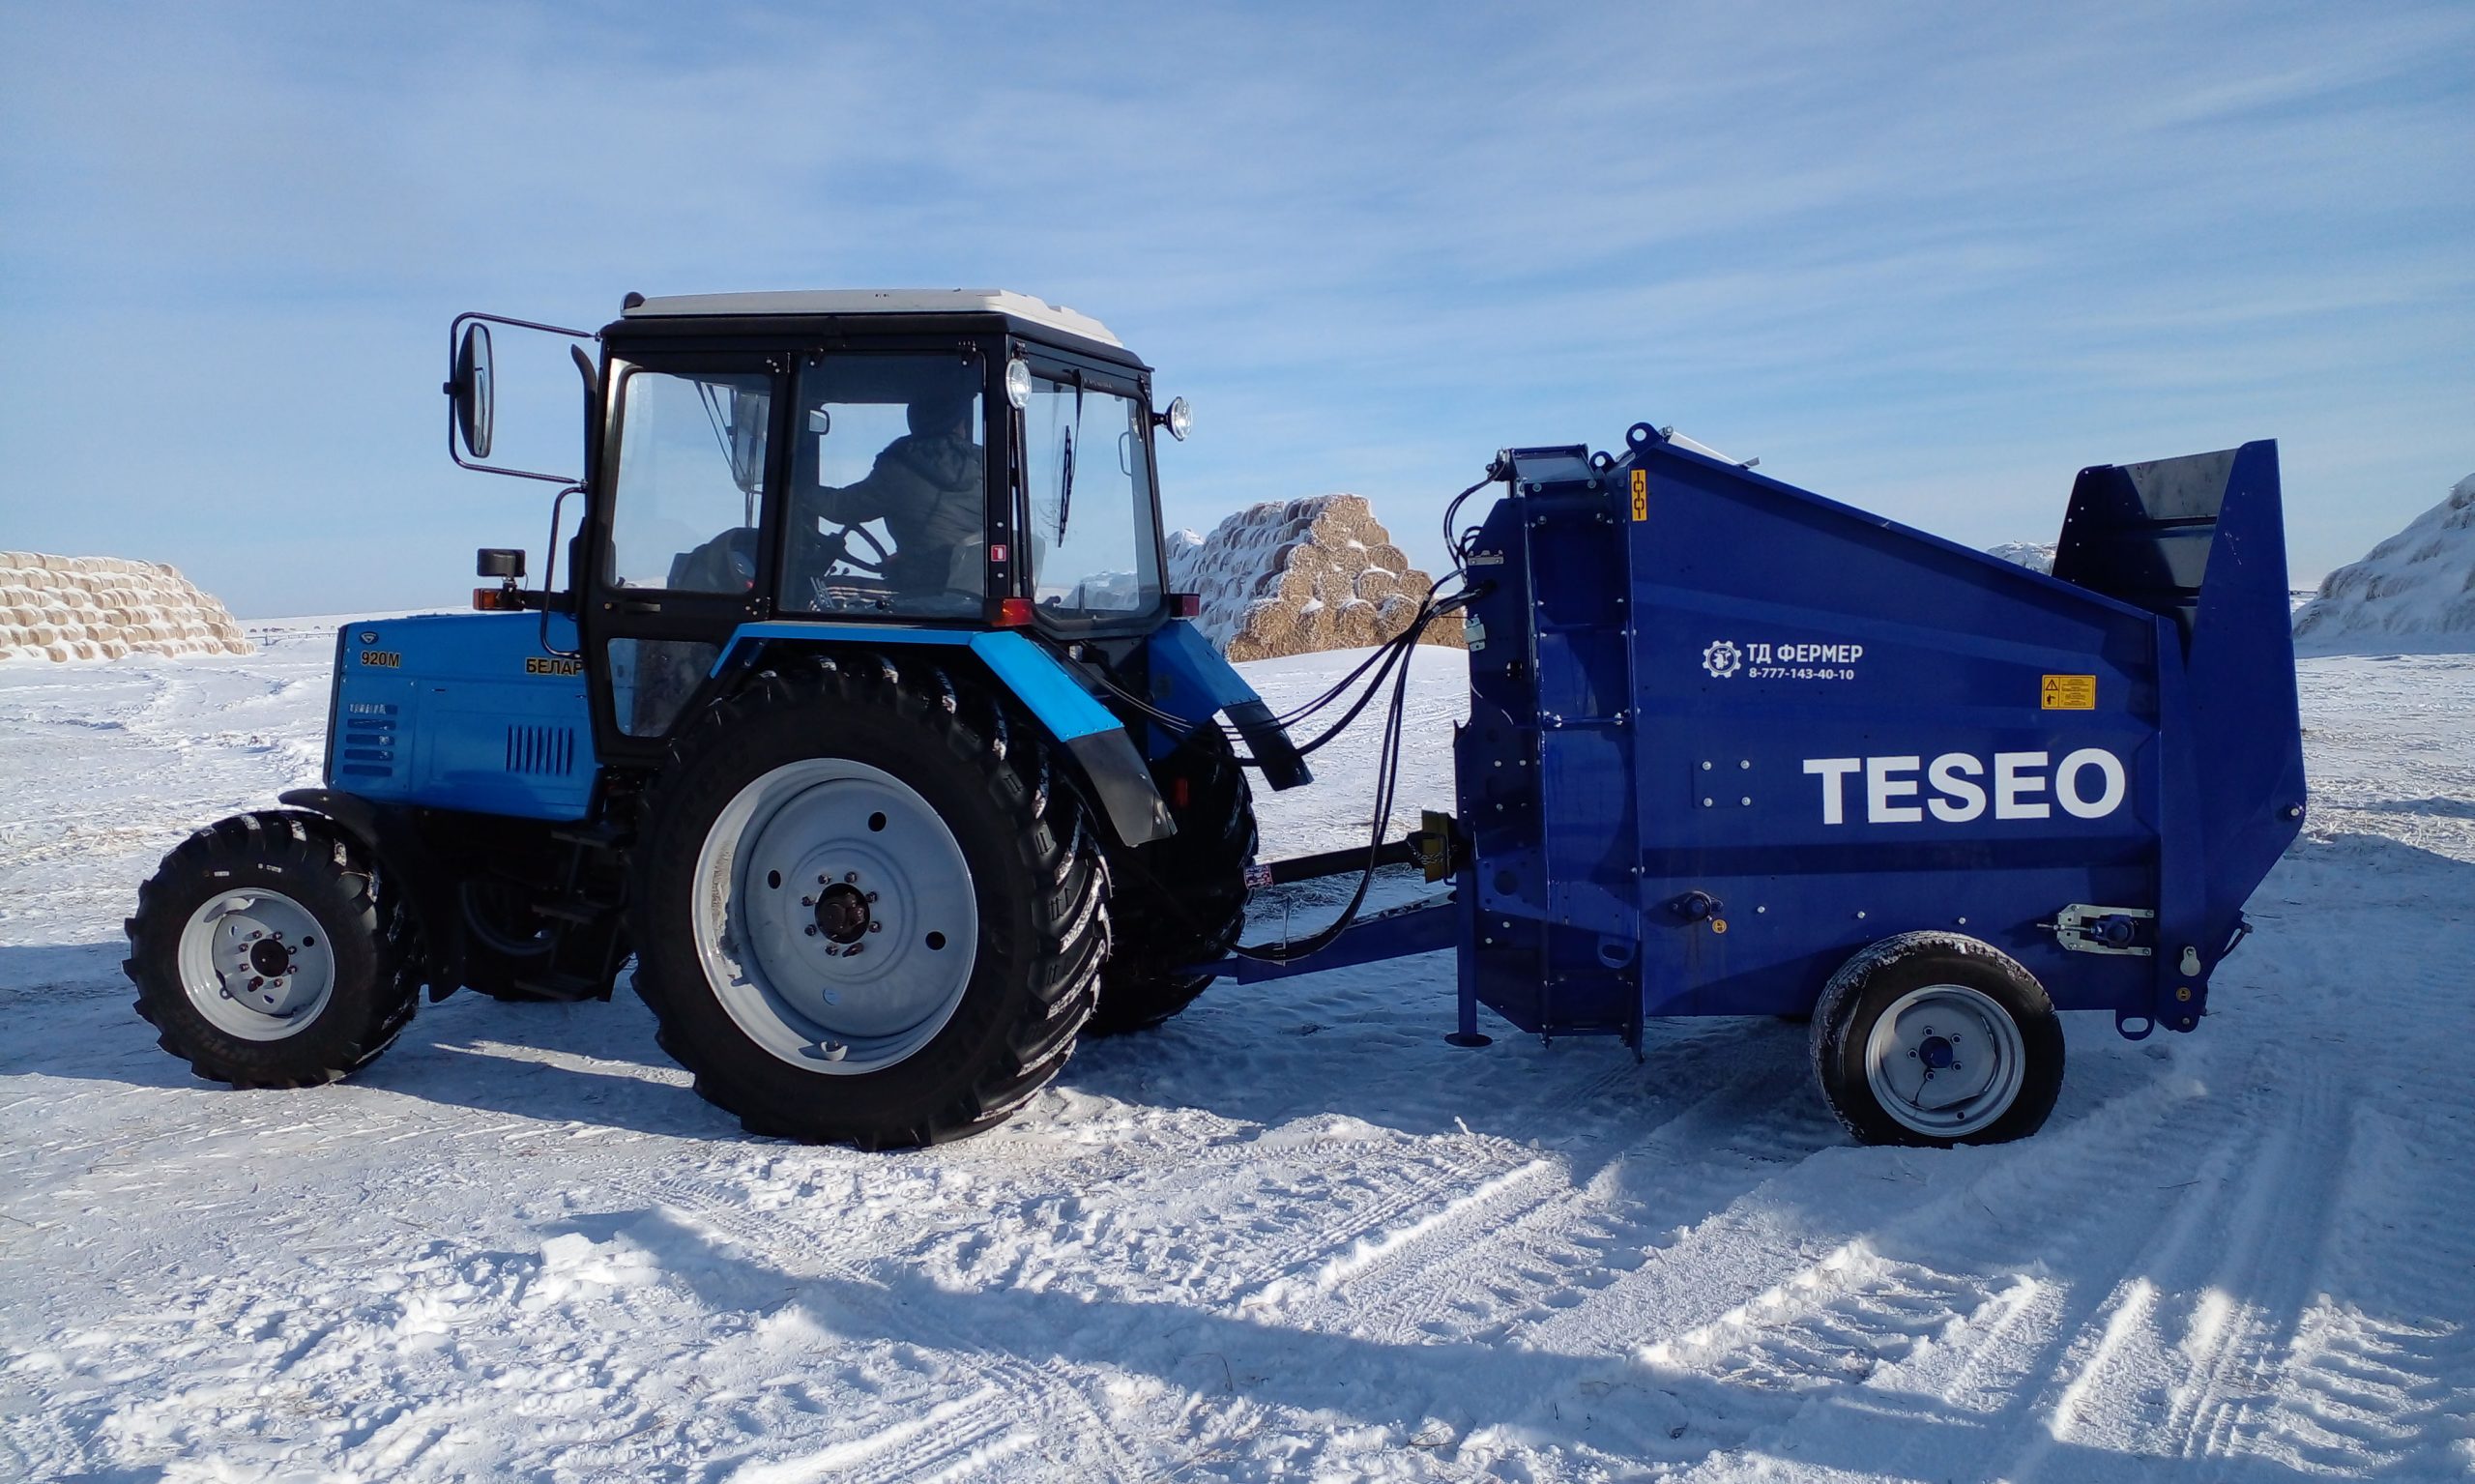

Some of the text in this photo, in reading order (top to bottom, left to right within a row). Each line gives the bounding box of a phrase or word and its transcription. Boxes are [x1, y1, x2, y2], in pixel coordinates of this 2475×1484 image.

[1746, 643, 1863, 664] ТД ФЕРМЕР
[525, 657, 584, 676] БЕЛАР
[1748, 667, 1854, 680] 8-777-143-40-10
[1803, 747, 2125, 825] TESEO
